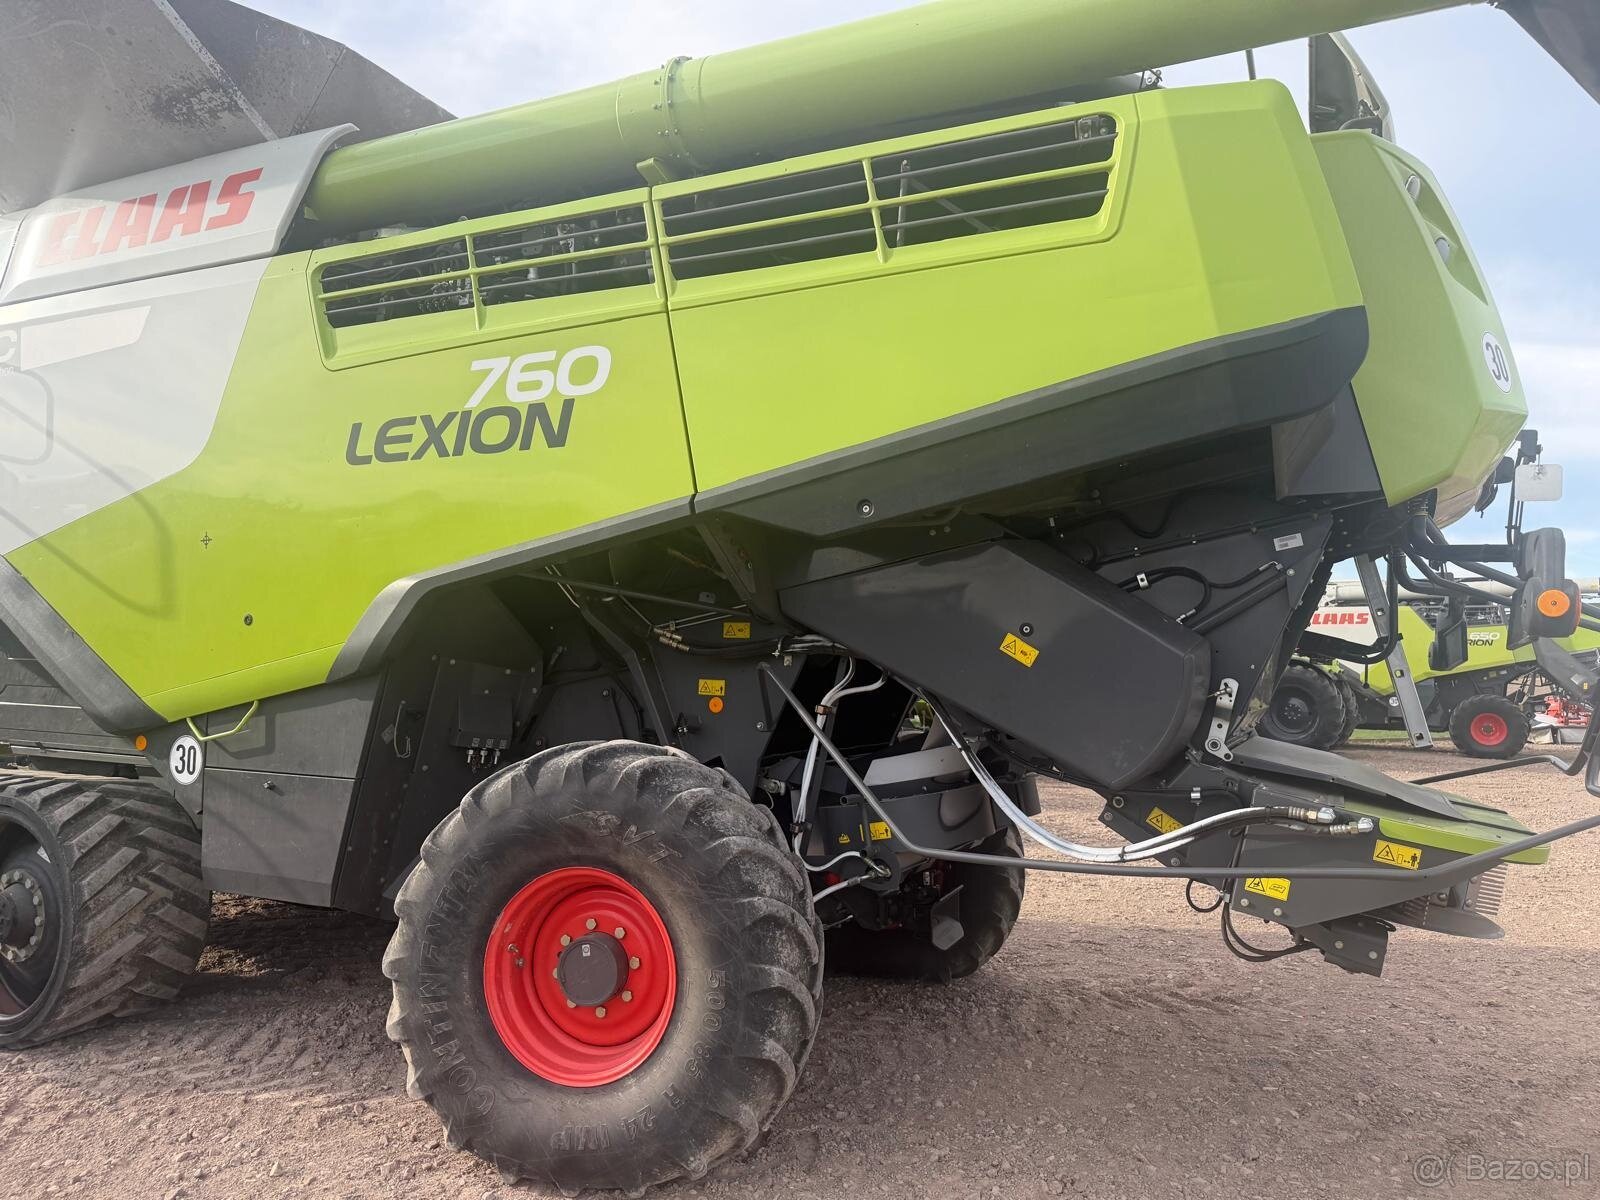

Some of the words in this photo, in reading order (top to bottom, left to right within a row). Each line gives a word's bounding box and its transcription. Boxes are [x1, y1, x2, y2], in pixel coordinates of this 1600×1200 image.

[36, 166, 264, 266] CLAAS
[464, 344, 612, 409] 760
[1484, 341, 1510, 383] 30
[345, 398, 576, 466] LEXION
[1310, 612, 1370, 625] LAAS
[1467, 639, 1494, 647] RION
[174, 743, 197, 776] 30
